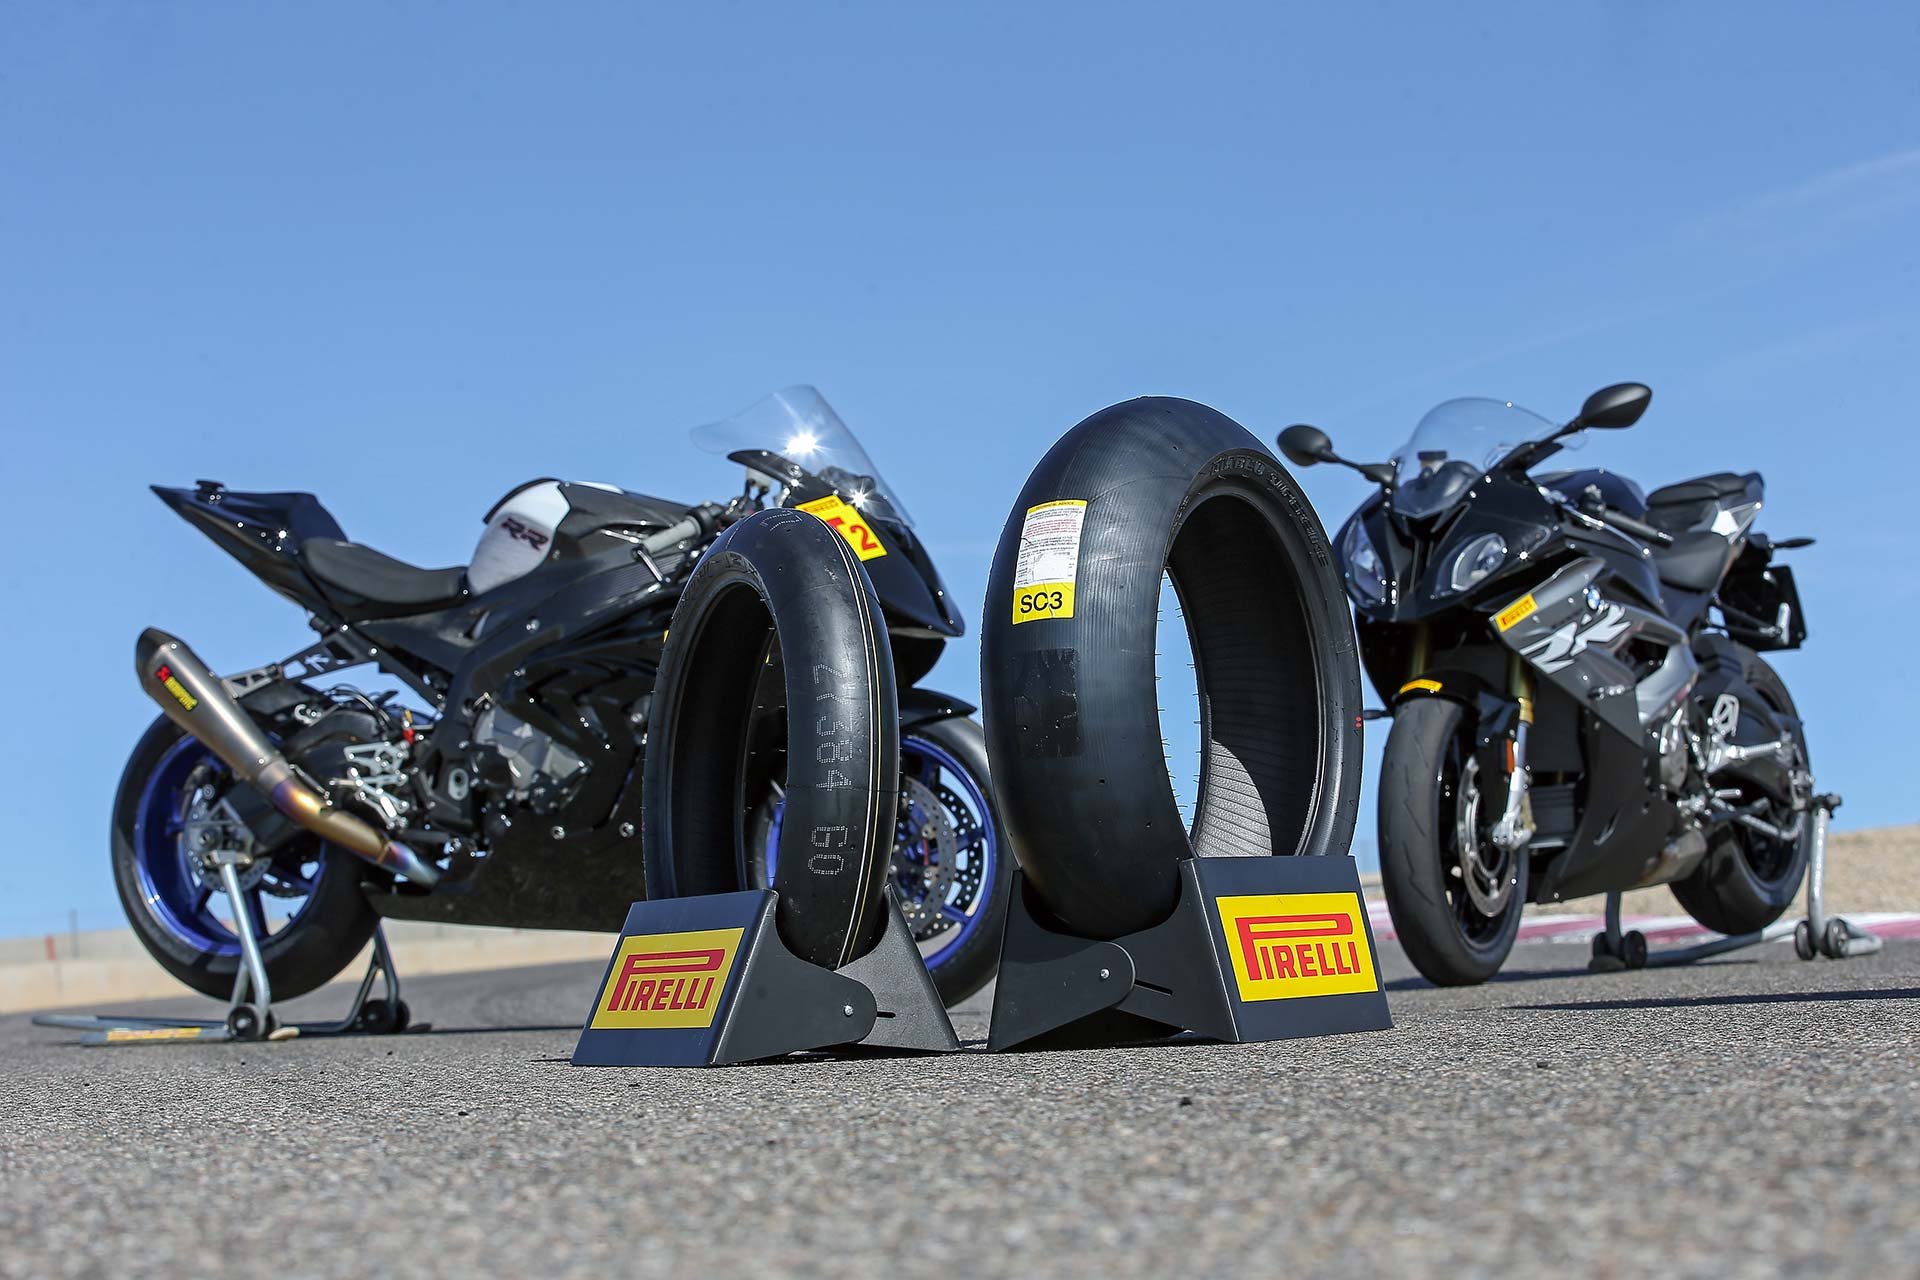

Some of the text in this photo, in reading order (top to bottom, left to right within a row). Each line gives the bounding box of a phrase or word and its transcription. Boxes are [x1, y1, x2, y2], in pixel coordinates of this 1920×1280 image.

[1020, 591, 1063, 613] SC3
[807, 825, 849, 876] 60
[1234, 912, 1361, 981] PIRELLI
[606, 948, 726, 1012] PIRELLI
